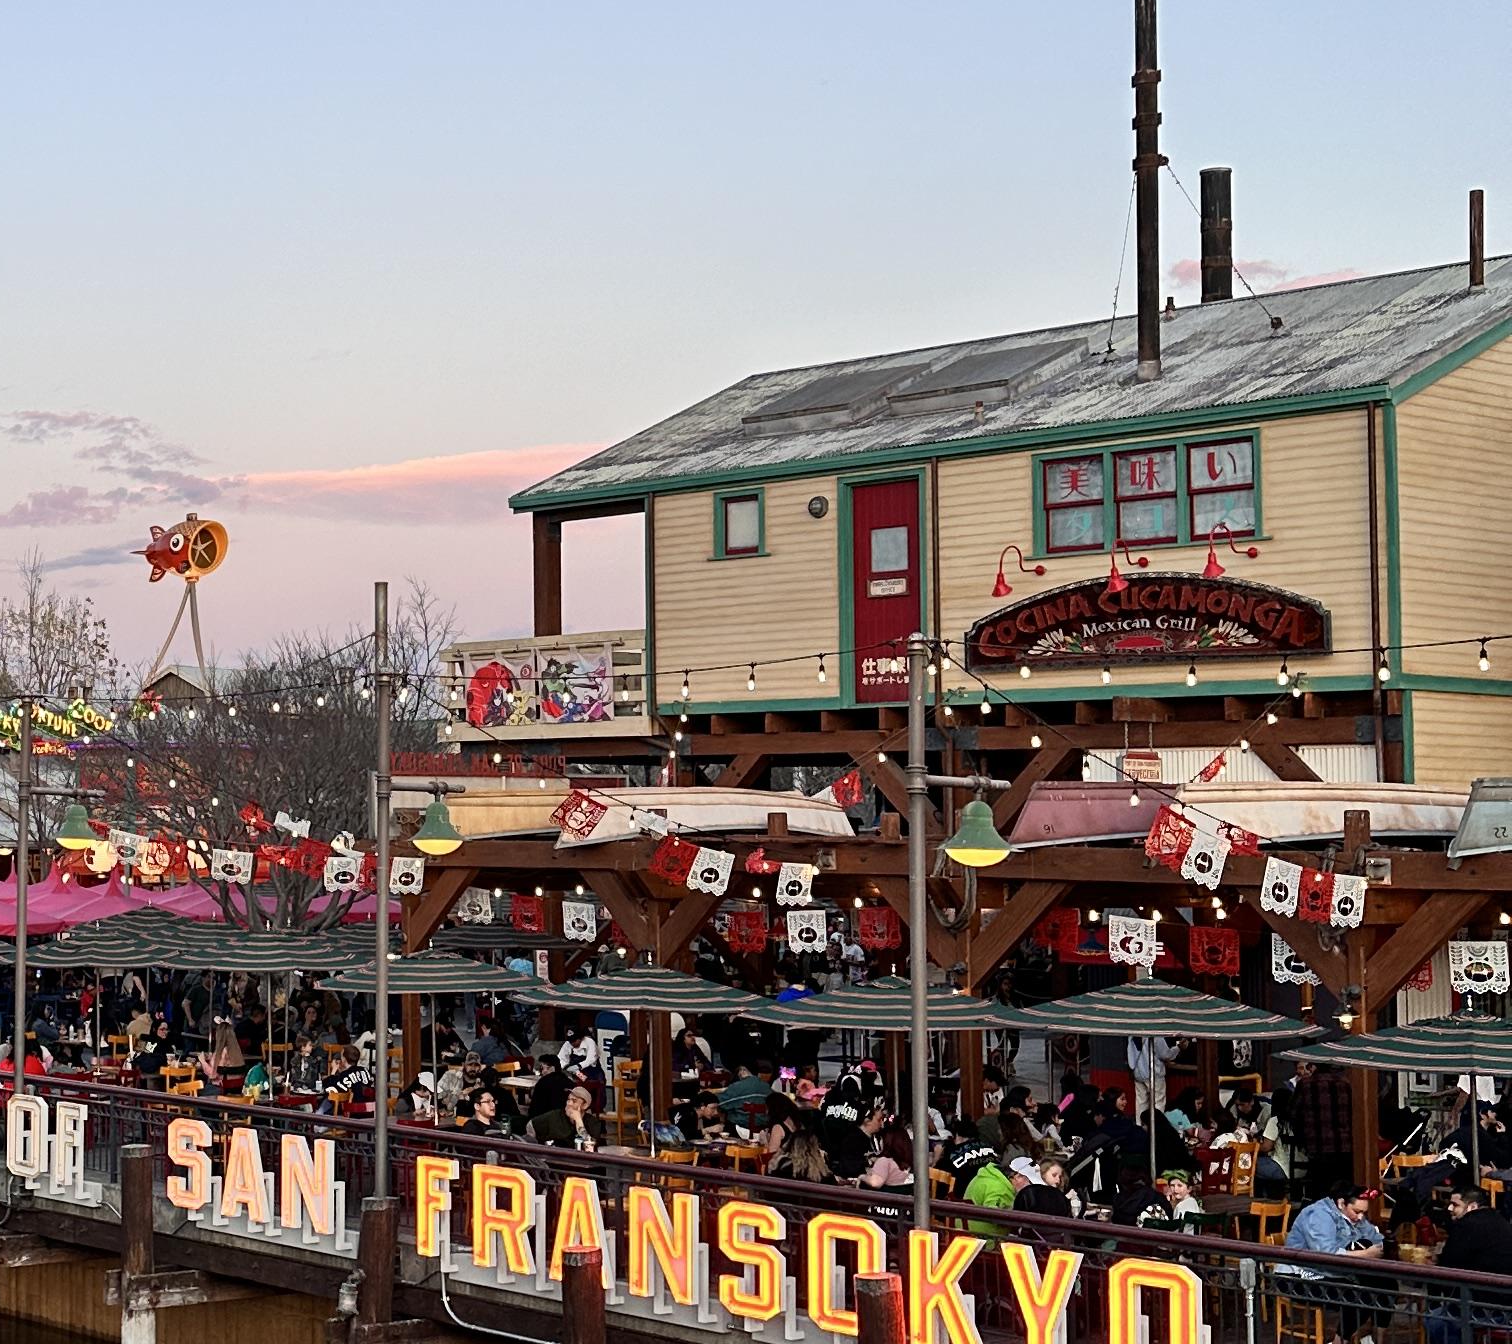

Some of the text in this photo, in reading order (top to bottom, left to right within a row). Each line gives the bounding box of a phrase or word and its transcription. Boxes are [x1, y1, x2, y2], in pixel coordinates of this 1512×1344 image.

[1060, 451, 1237, 499] 美味い
[978, 580, 1307, 657] COCINA CUCAMONGA
[1082, 615, 1197, 638] Mexican Grill
[7, 1093, 88, 1187] OF
[167, 1117, 336, 1235] SAN
